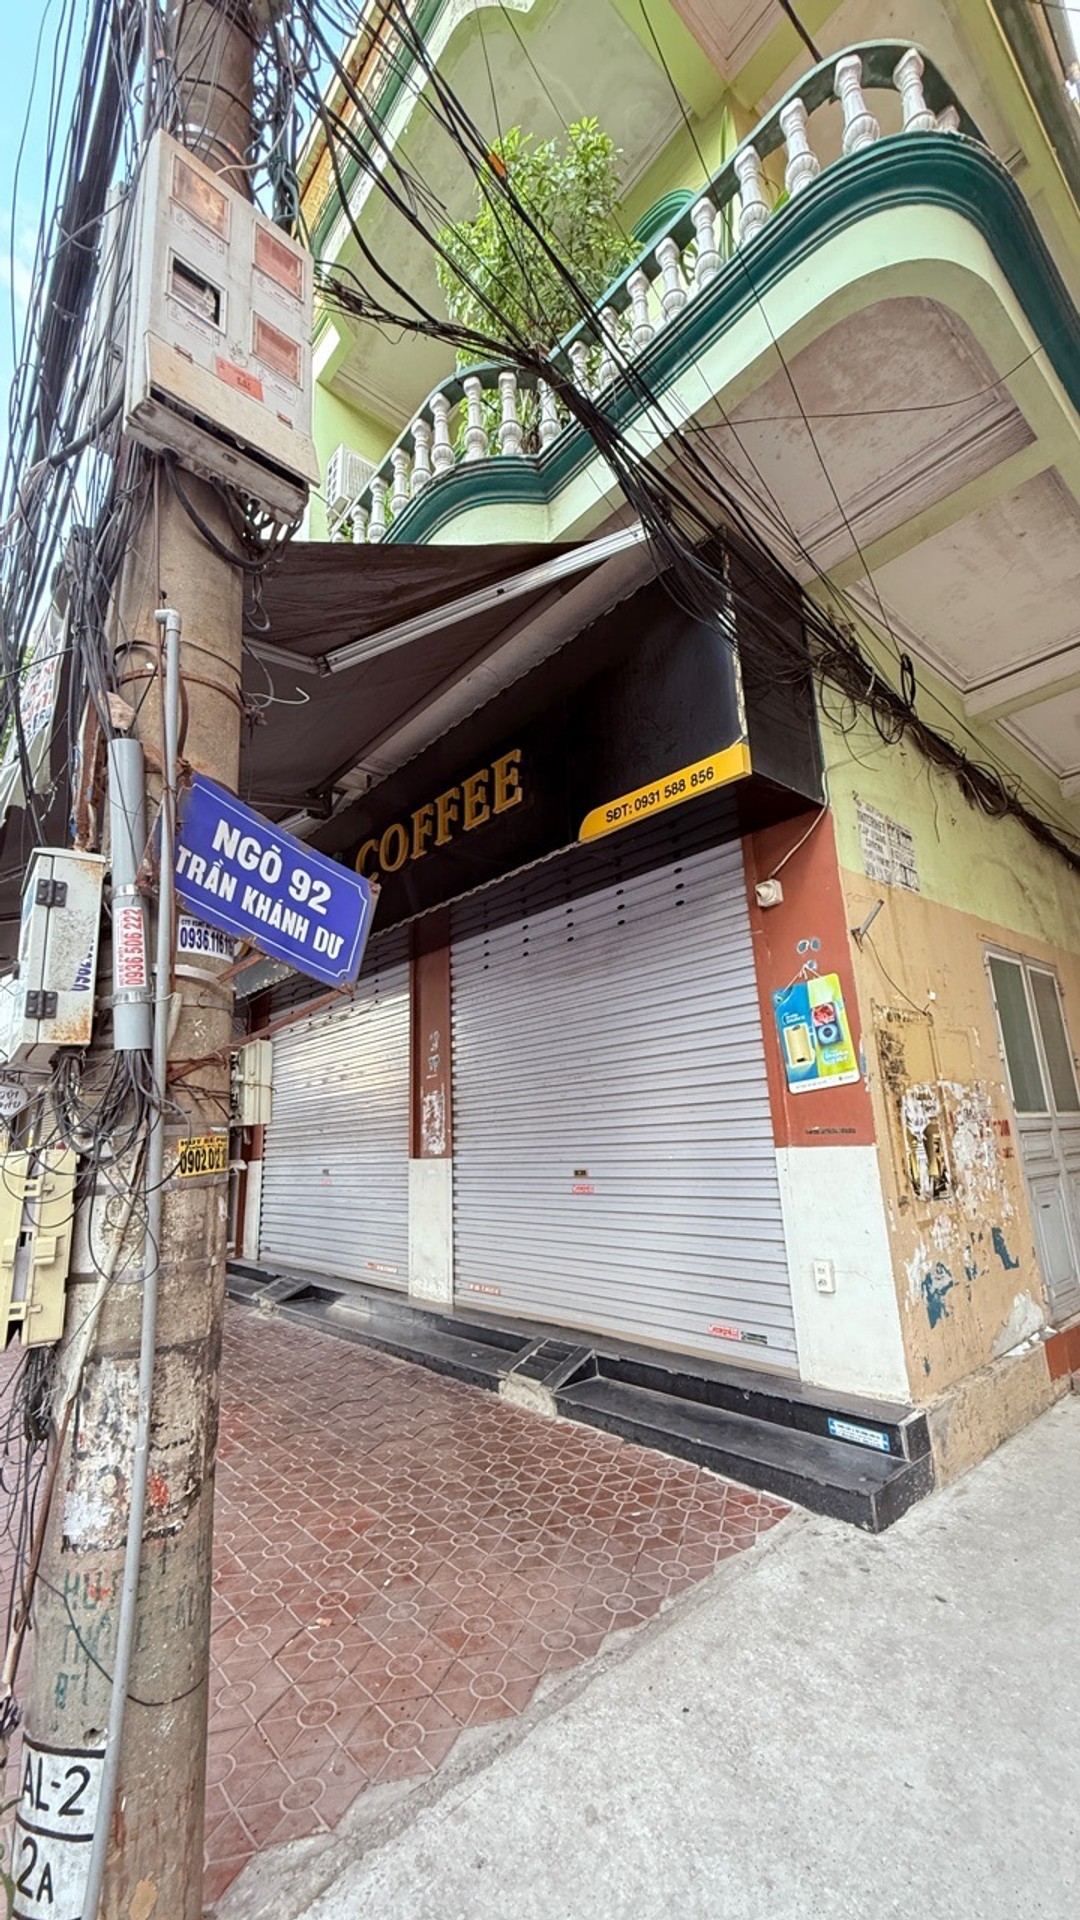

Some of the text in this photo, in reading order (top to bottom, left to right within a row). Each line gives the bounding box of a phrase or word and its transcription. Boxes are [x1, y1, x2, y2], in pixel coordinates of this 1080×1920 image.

[355, 749, 523, 883] COFFEE
[634, 790, 660, 811] 0931
[664, 778, 686, 798] 588
[690, 766, 714, 787] 856
[175, 844, 344, 960] TRẦN KHÁNH DƯ
[211, 818, 332, 915] NGÕ 92
[21, 1751, 91, 1818] AL-2
